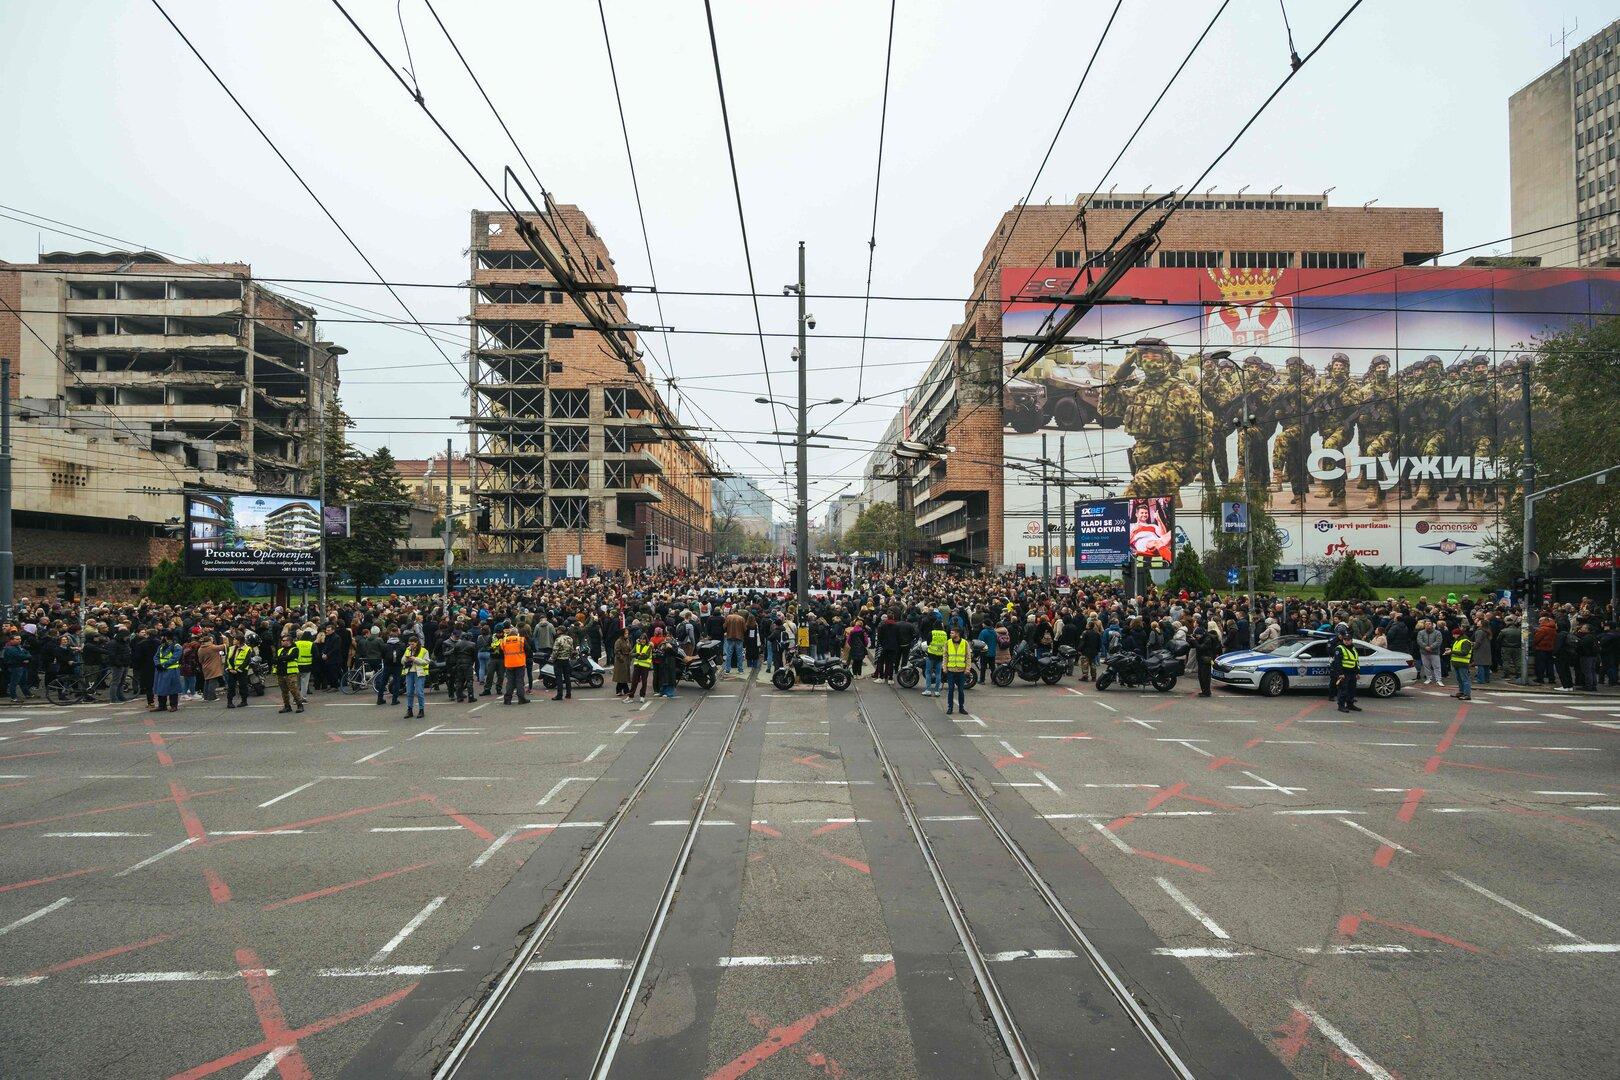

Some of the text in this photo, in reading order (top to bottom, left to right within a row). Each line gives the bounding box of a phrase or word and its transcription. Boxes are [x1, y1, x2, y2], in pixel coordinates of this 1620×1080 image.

[1306, 448, 1526, 490] Служим
[1355, 522, 1388, 531] partizan
[205, 549, 313, 561] Prostor. Oplemenjen.
[393, 578, 435, 586] ОДБРАНЕ
